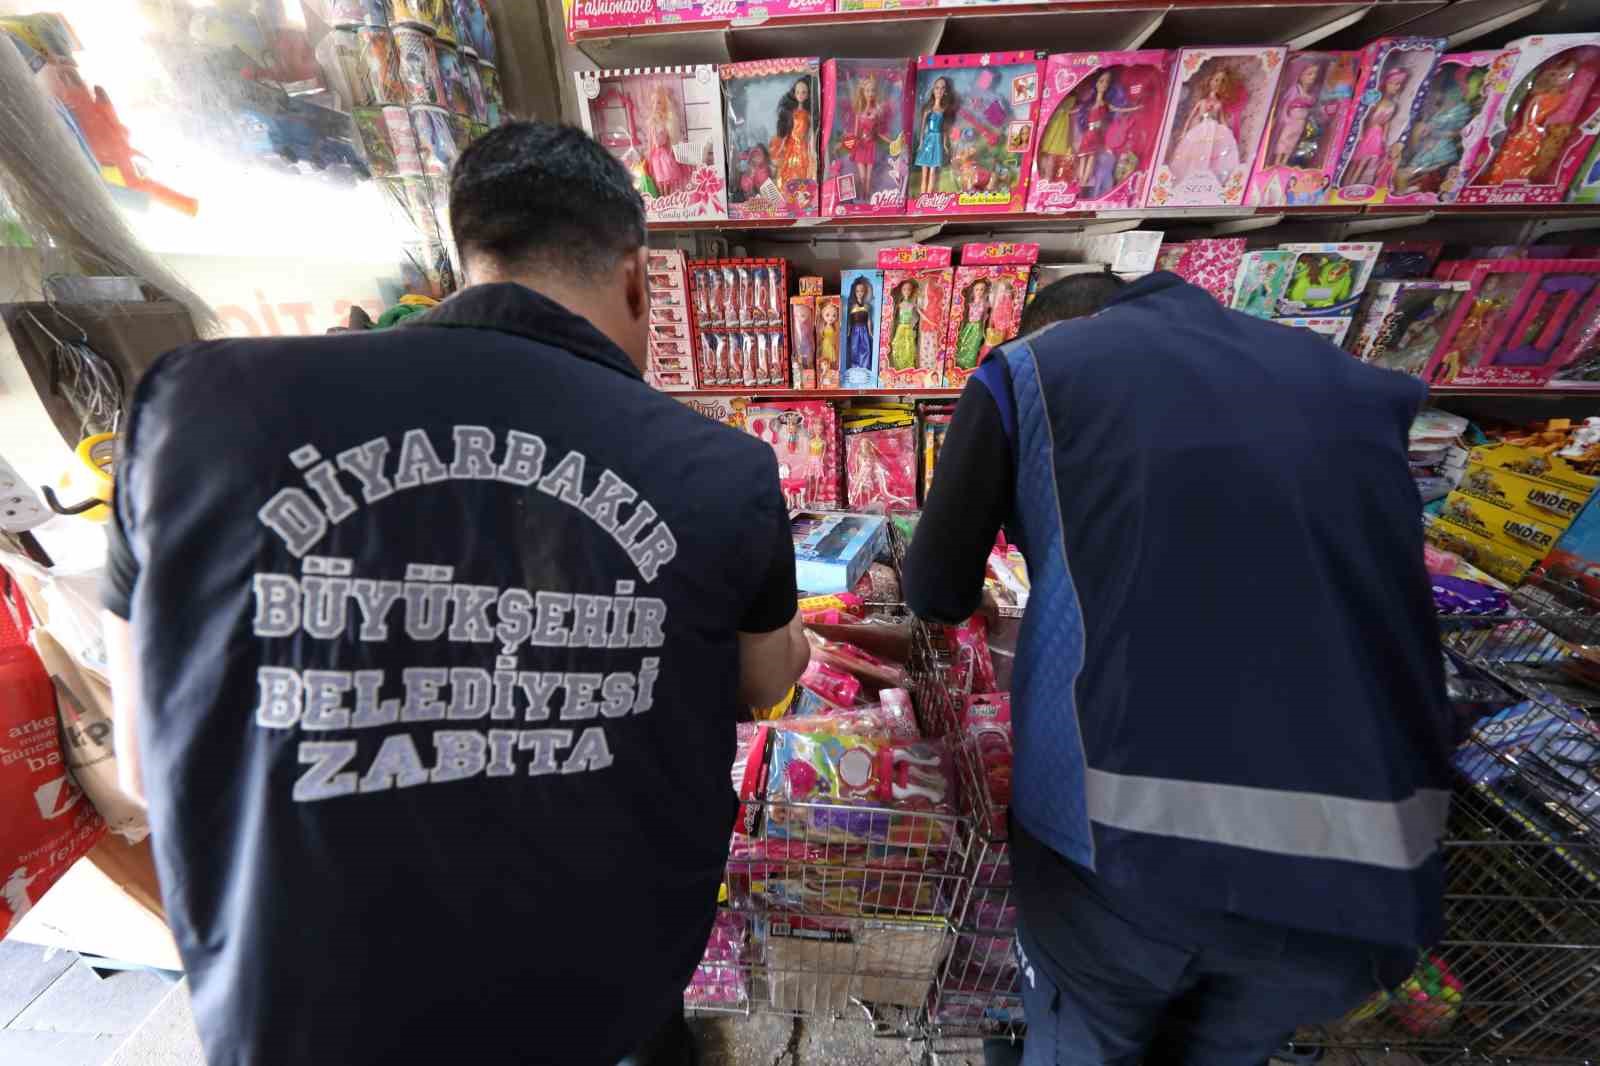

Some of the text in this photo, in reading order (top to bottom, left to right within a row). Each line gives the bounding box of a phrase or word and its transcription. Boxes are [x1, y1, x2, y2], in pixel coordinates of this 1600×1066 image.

[257, 424, 678, 584] DİYARBAKIR
[1503, 519, 1553, 547] UNDER
[1527, 488, 1581, 514] UNDER
[252, 554, 668, 655] BÜYÜKŞEHİR
[255, 654, 661, 732] BELEDİYESİ
[292, 725, 615, 803] ZABITA
